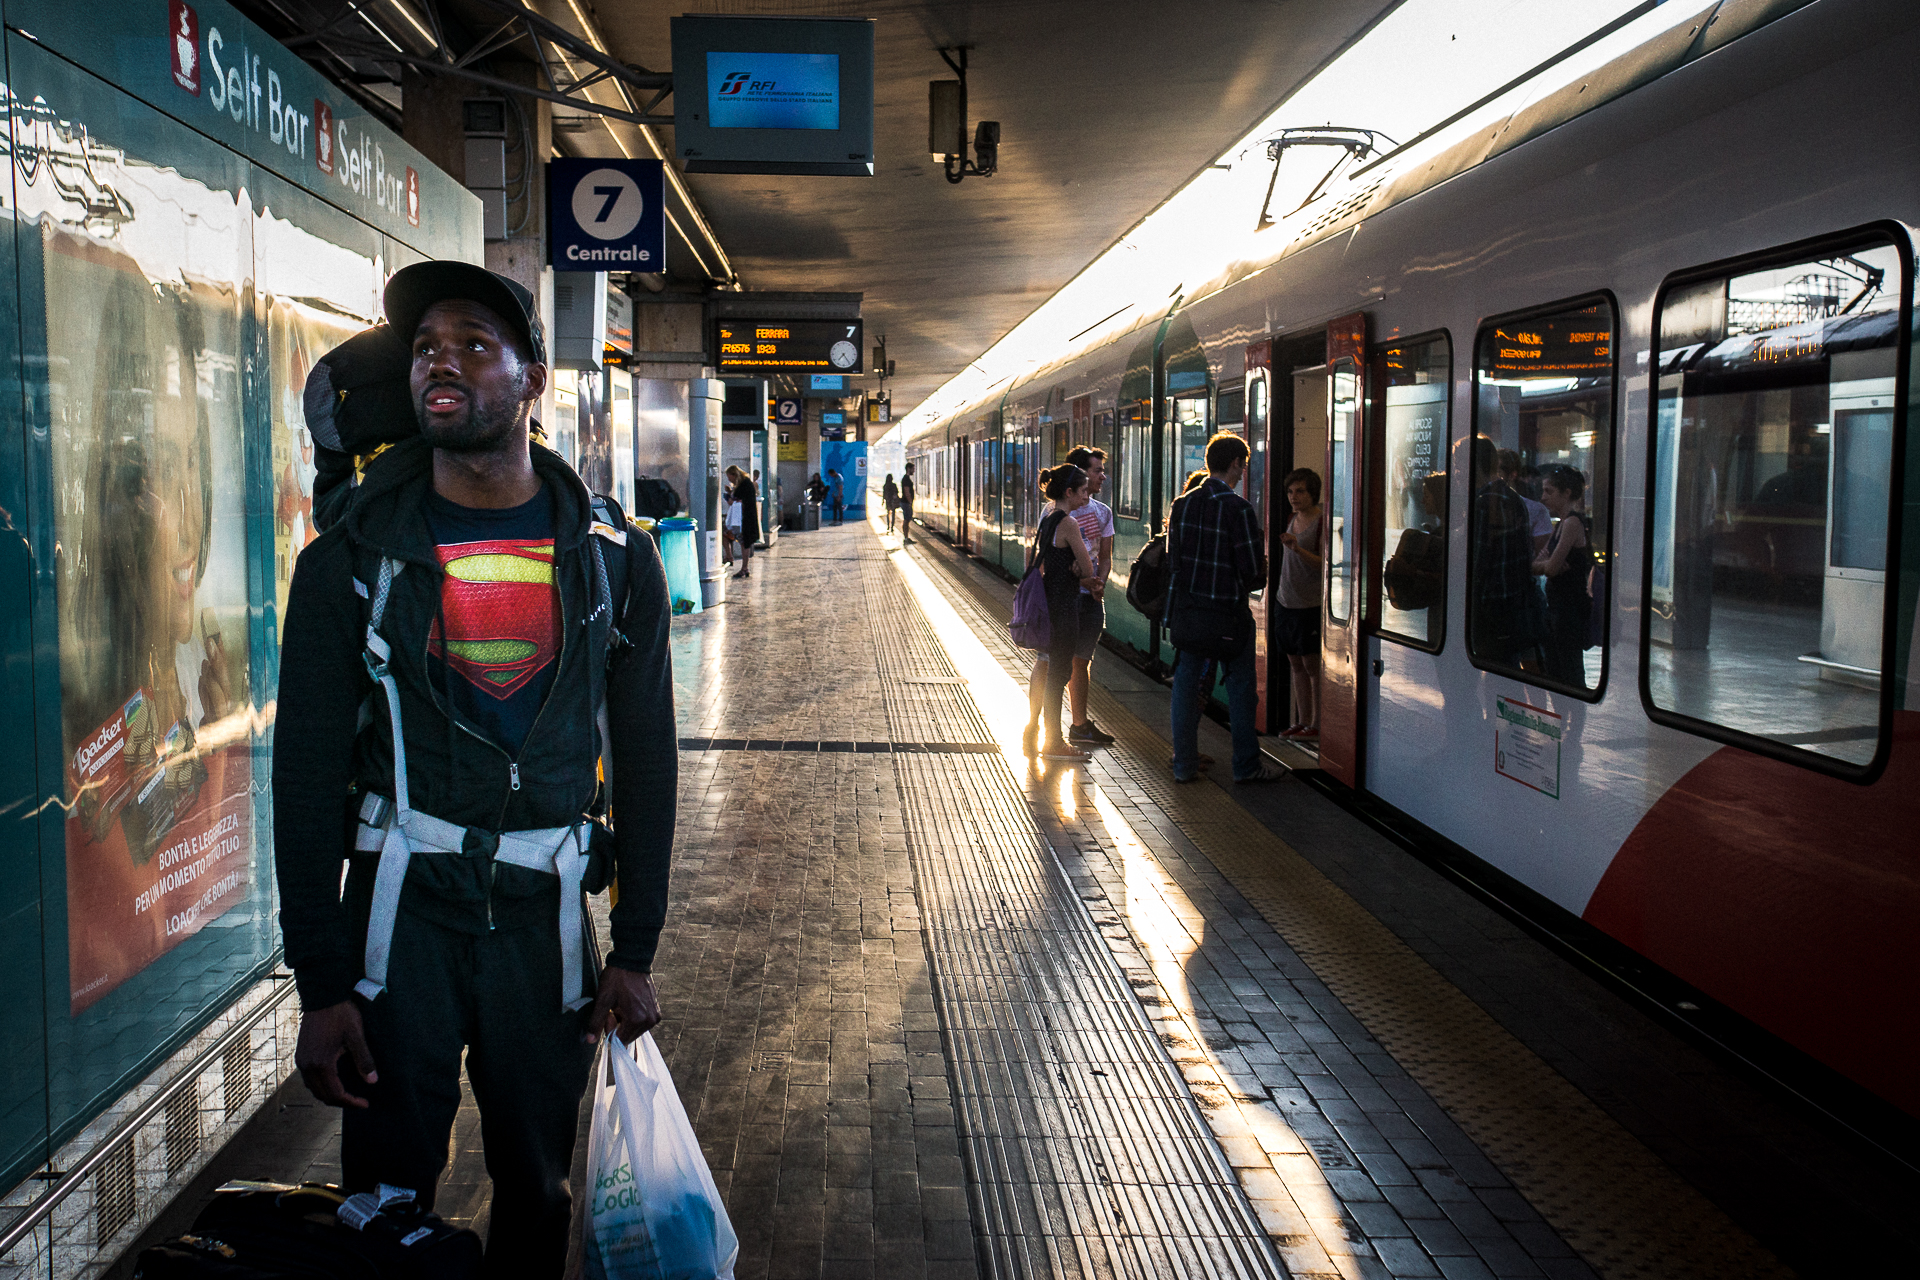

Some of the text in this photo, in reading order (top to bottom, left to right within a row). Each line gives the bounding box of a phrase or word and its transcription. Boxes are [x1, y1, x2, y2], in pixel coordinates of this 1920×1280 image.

[208, 27, 309, 160] Self Bar
[749, 81, 776, 91] RFI
[338, 119, 403, 217] Self Bar
[594, 186, 624, 222] 7
[566, 244, 650, 261] Centrale
[756, 329, 789, 339] FERRARA
[846, 326, 856, 338] 7
[784, 403, 794, 415] 7
[781, 433, 789, 443] T
[73, 717, 123, 777] Loacker
[159, 838, 191, 870] BONTÀ
[191, 837, 198, 855] E
[136, 890, 151, 915] PER
[150, 882, 160, 904] UN
[159, 858, 206, 896] MOMENTO
[221, 835, 240, 856] TUO
[212, 870, 239, 901] BONTÀ!
